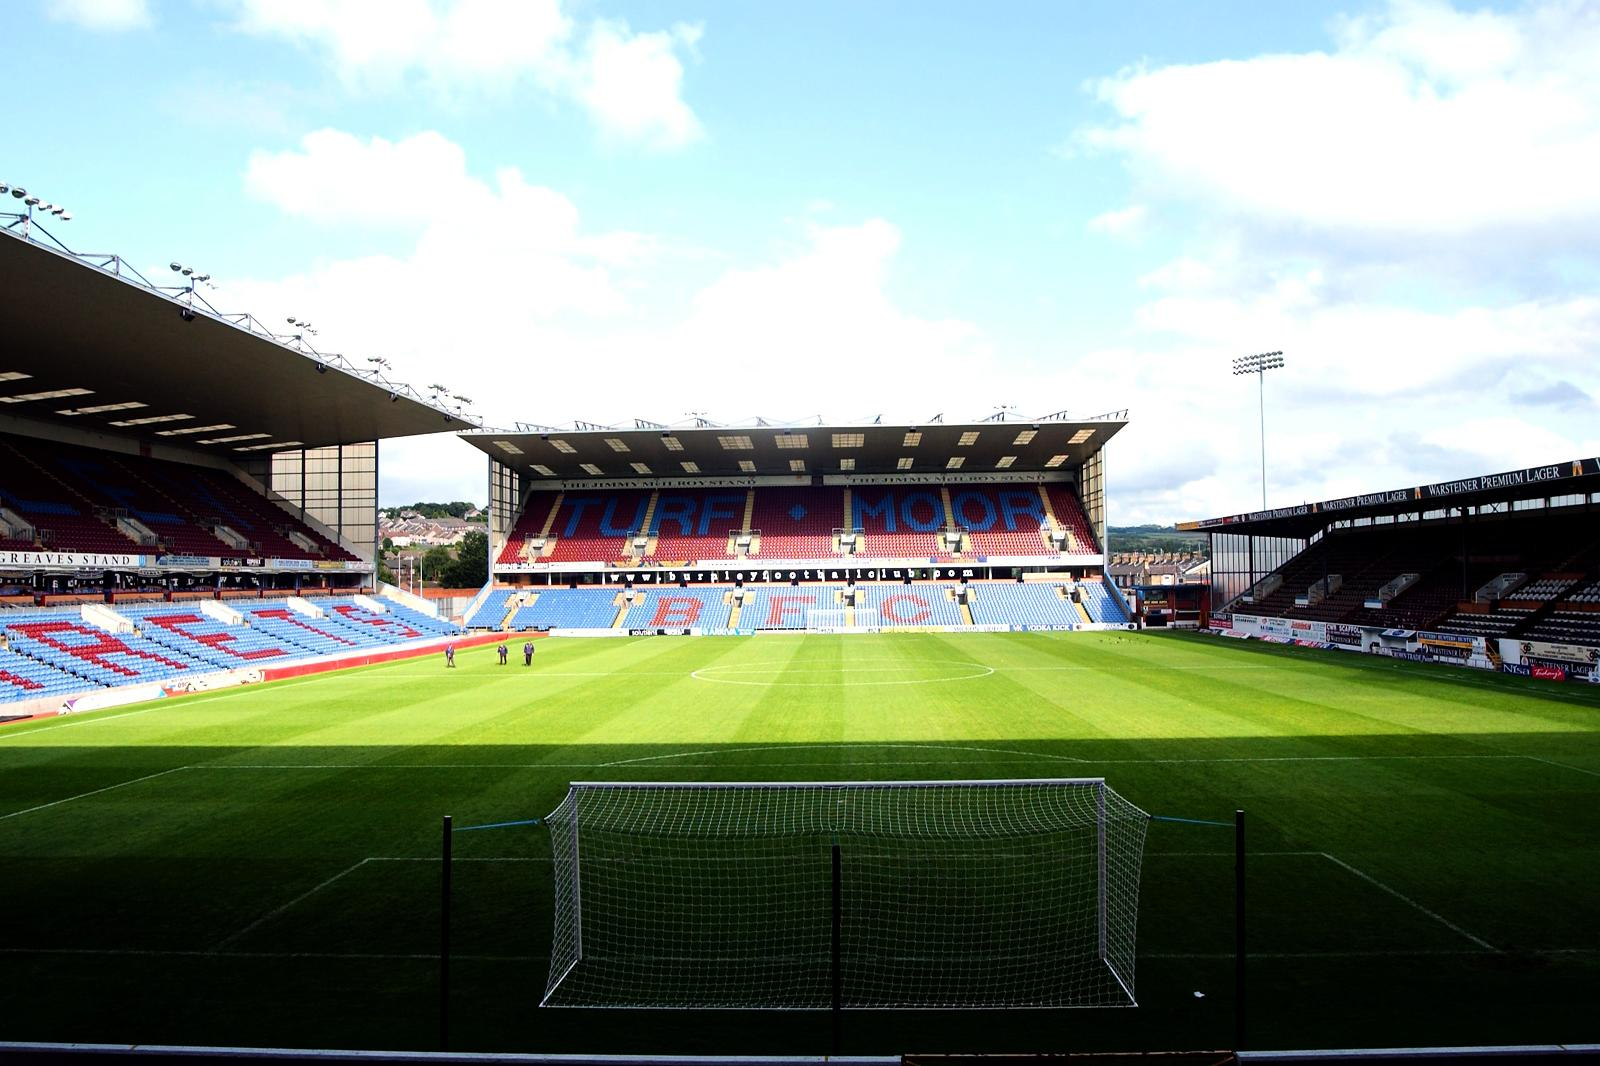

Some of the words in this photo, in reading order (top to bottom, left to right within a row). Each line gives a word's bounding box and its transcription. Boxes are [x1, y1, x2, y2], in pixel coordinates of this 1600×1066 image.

[562, 482, 590, 490] THE
[709, 479, 756, 487] STAND
[1428, 479, 1478, 496] WARSTEINER
[1480, 470, 1523, 489] PREMIUM
[1526, 466, 1560, 482] LAGER
[1322, 498, 1356, 509] WARSTEINER
[1357, 494, 1385, 506] PREMIUM
[1386, 491, 1408, 502] LAGER
[563, 496, 748, 538] TURF
[851, 490, 1044, 533] MOOR
[1293, 507, 1308, 515] LAGER
[83, 555, 131, 565] STAND
[609, 569, 974, 583] www.burnleyfootballclub.com
[1503, 664, 1530, 676] Nisa
